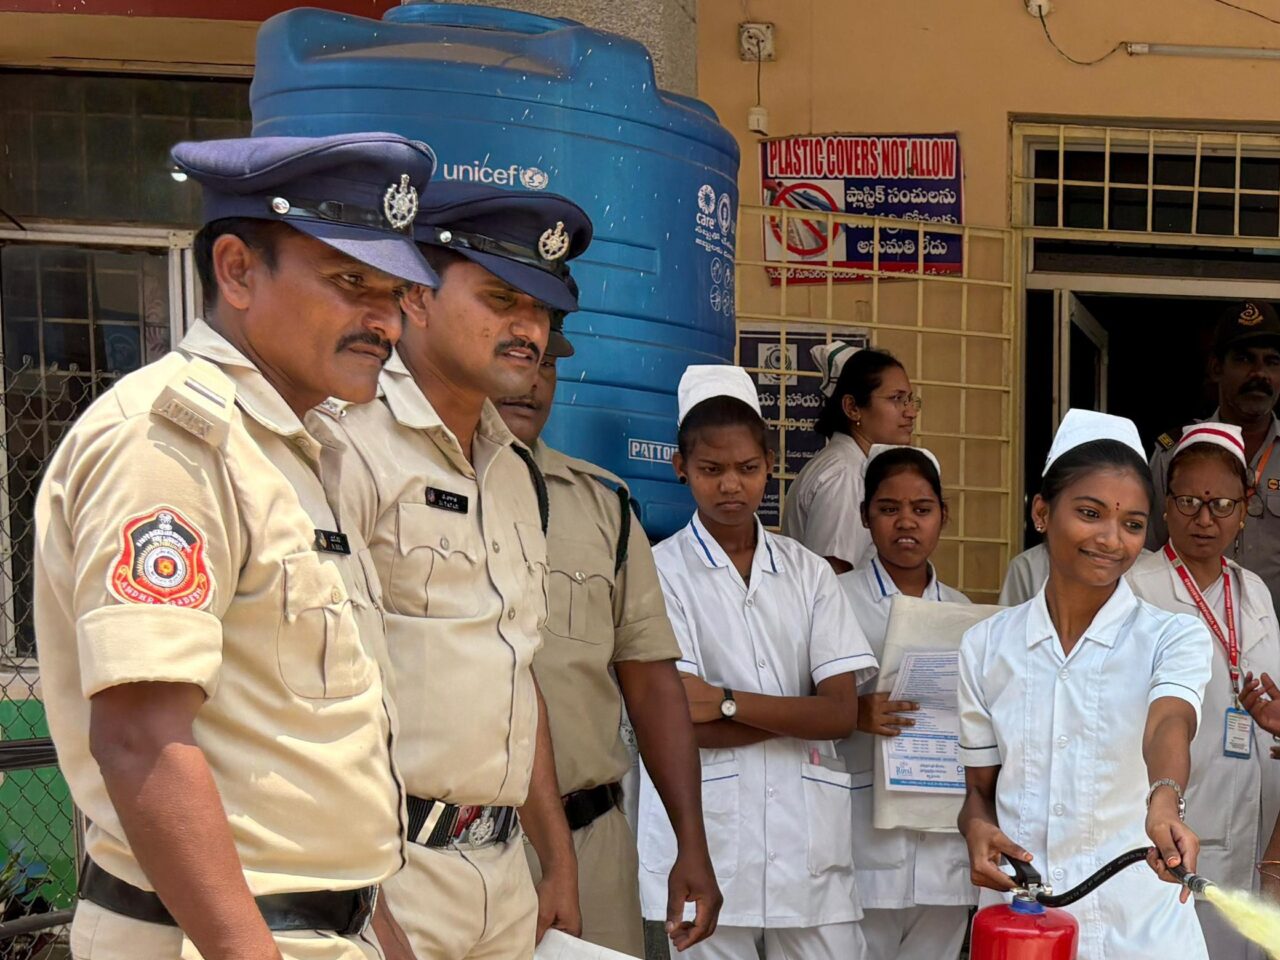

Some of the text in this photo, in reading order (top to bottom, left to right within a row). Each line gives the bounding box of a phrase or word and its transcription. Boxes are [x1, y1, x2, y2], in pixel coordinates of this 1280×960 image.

[769, 137, 956, 178] PLASTIC COVERS NOT ALLOW
[443, 161, 518, 186] unicef
[887, 187, 956, 205] సంచులను
[696, 212, 715, 229] care
[121, 581, 202, 605] ANDHR RADESH
